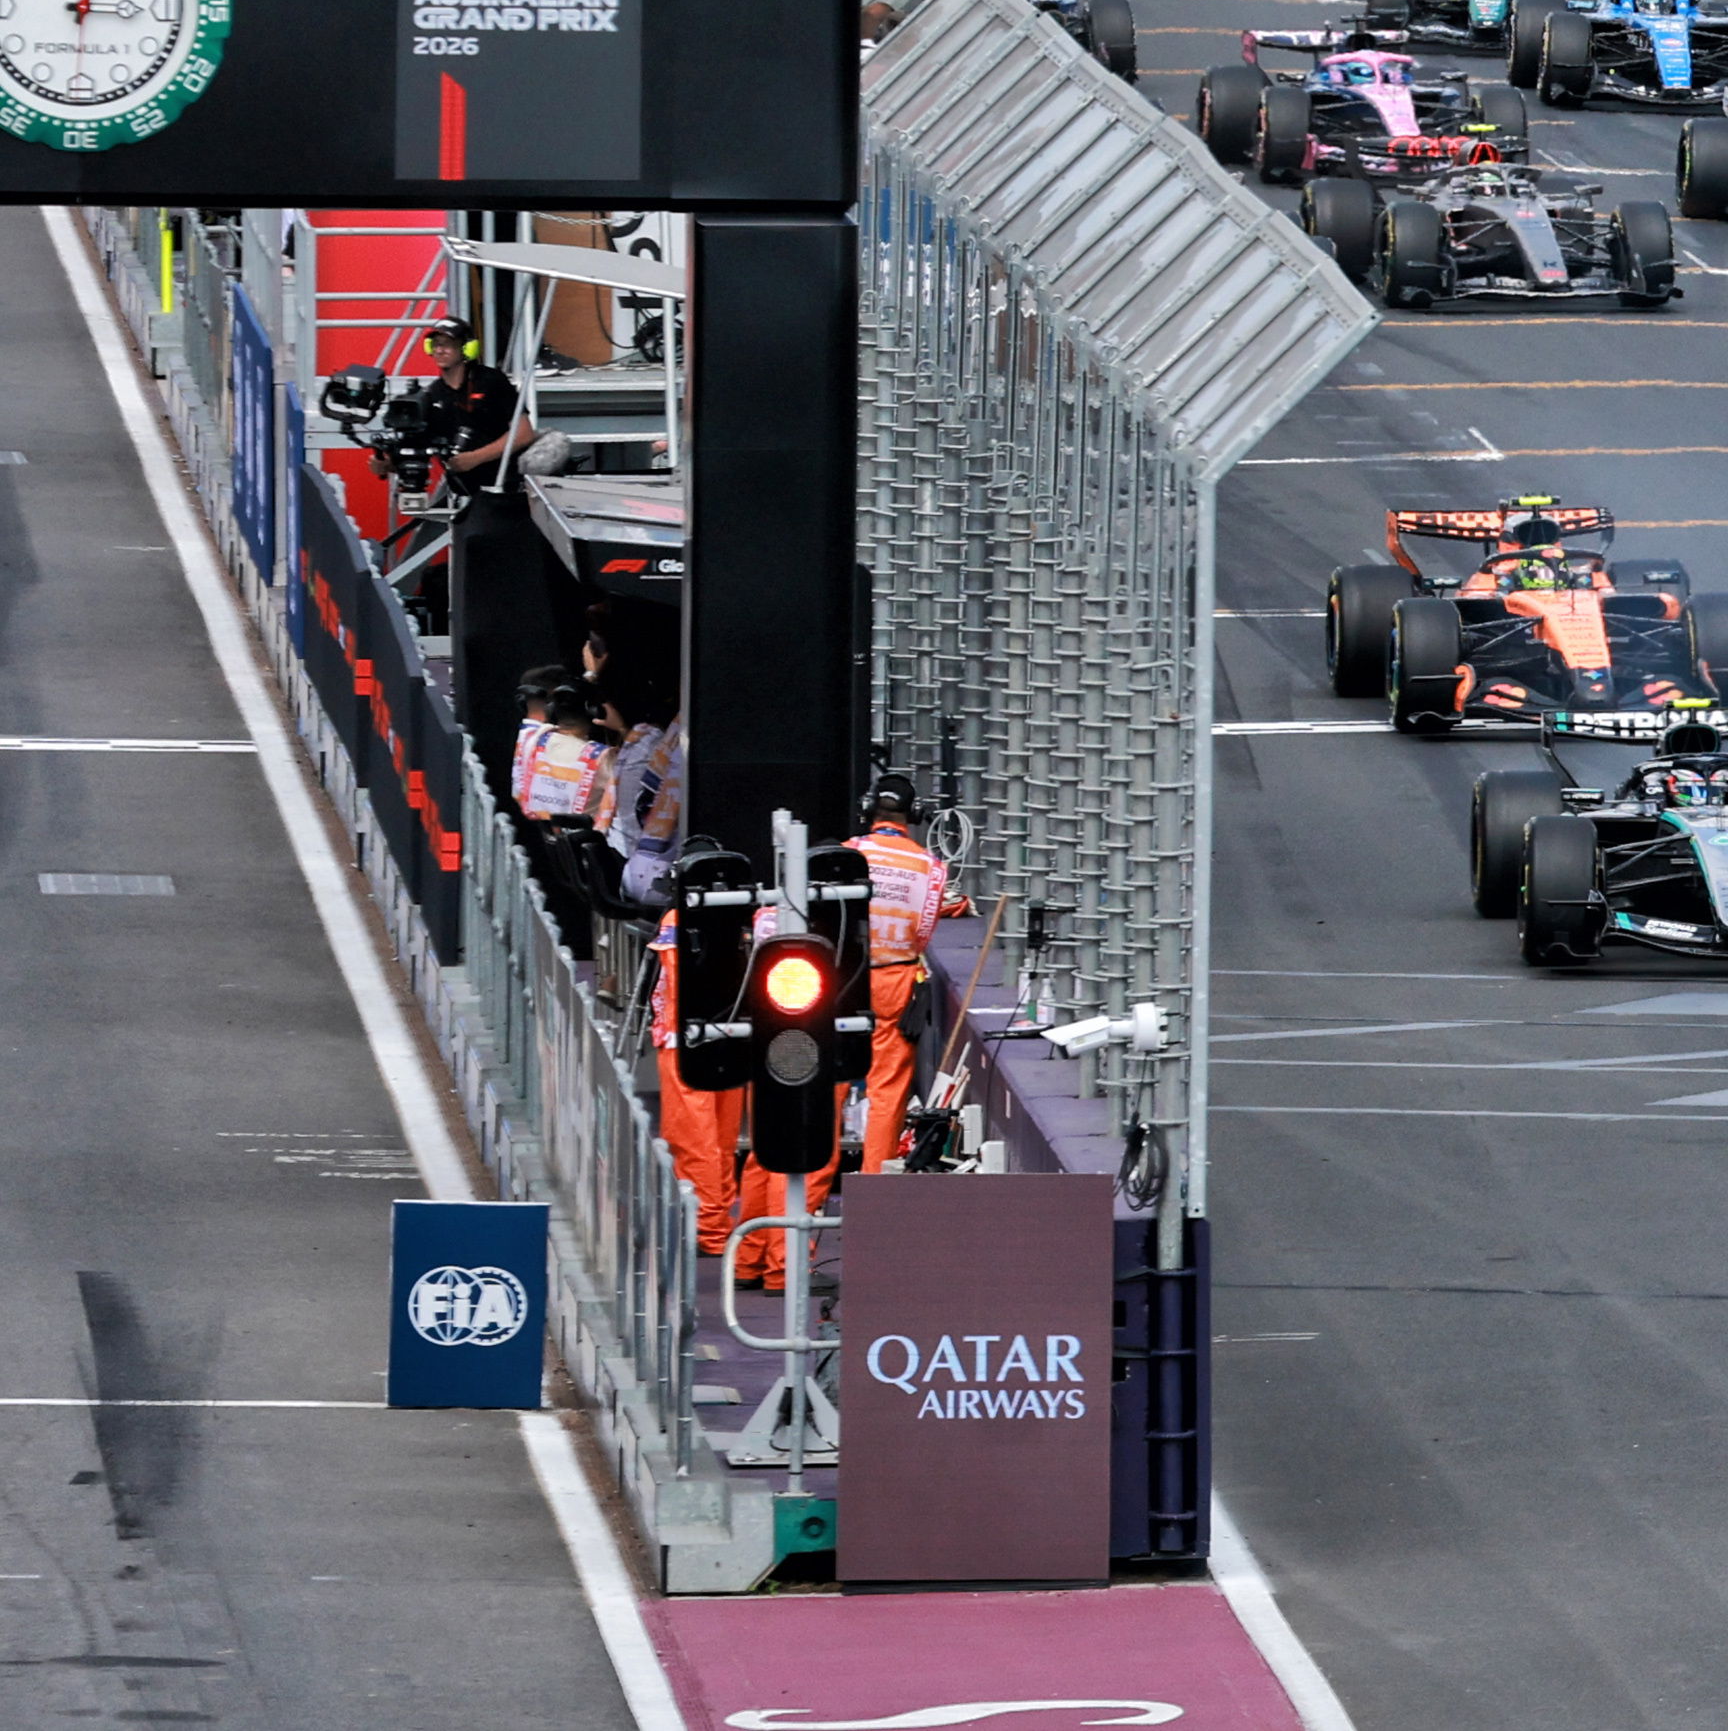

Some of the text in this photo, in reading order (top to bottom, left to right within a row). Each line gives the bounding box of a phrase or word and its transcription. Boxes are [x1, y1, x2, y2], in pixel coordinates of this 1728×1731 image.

[412, 7, 619, 32] GRAND PRIX
[34, 42, 118, 54] FORMULA
[412, 37, 480, 56] 2026
[867, 1334, 1084, 1395] QATAR
[917, 1389, 1086, 1419] AIRWAYS
